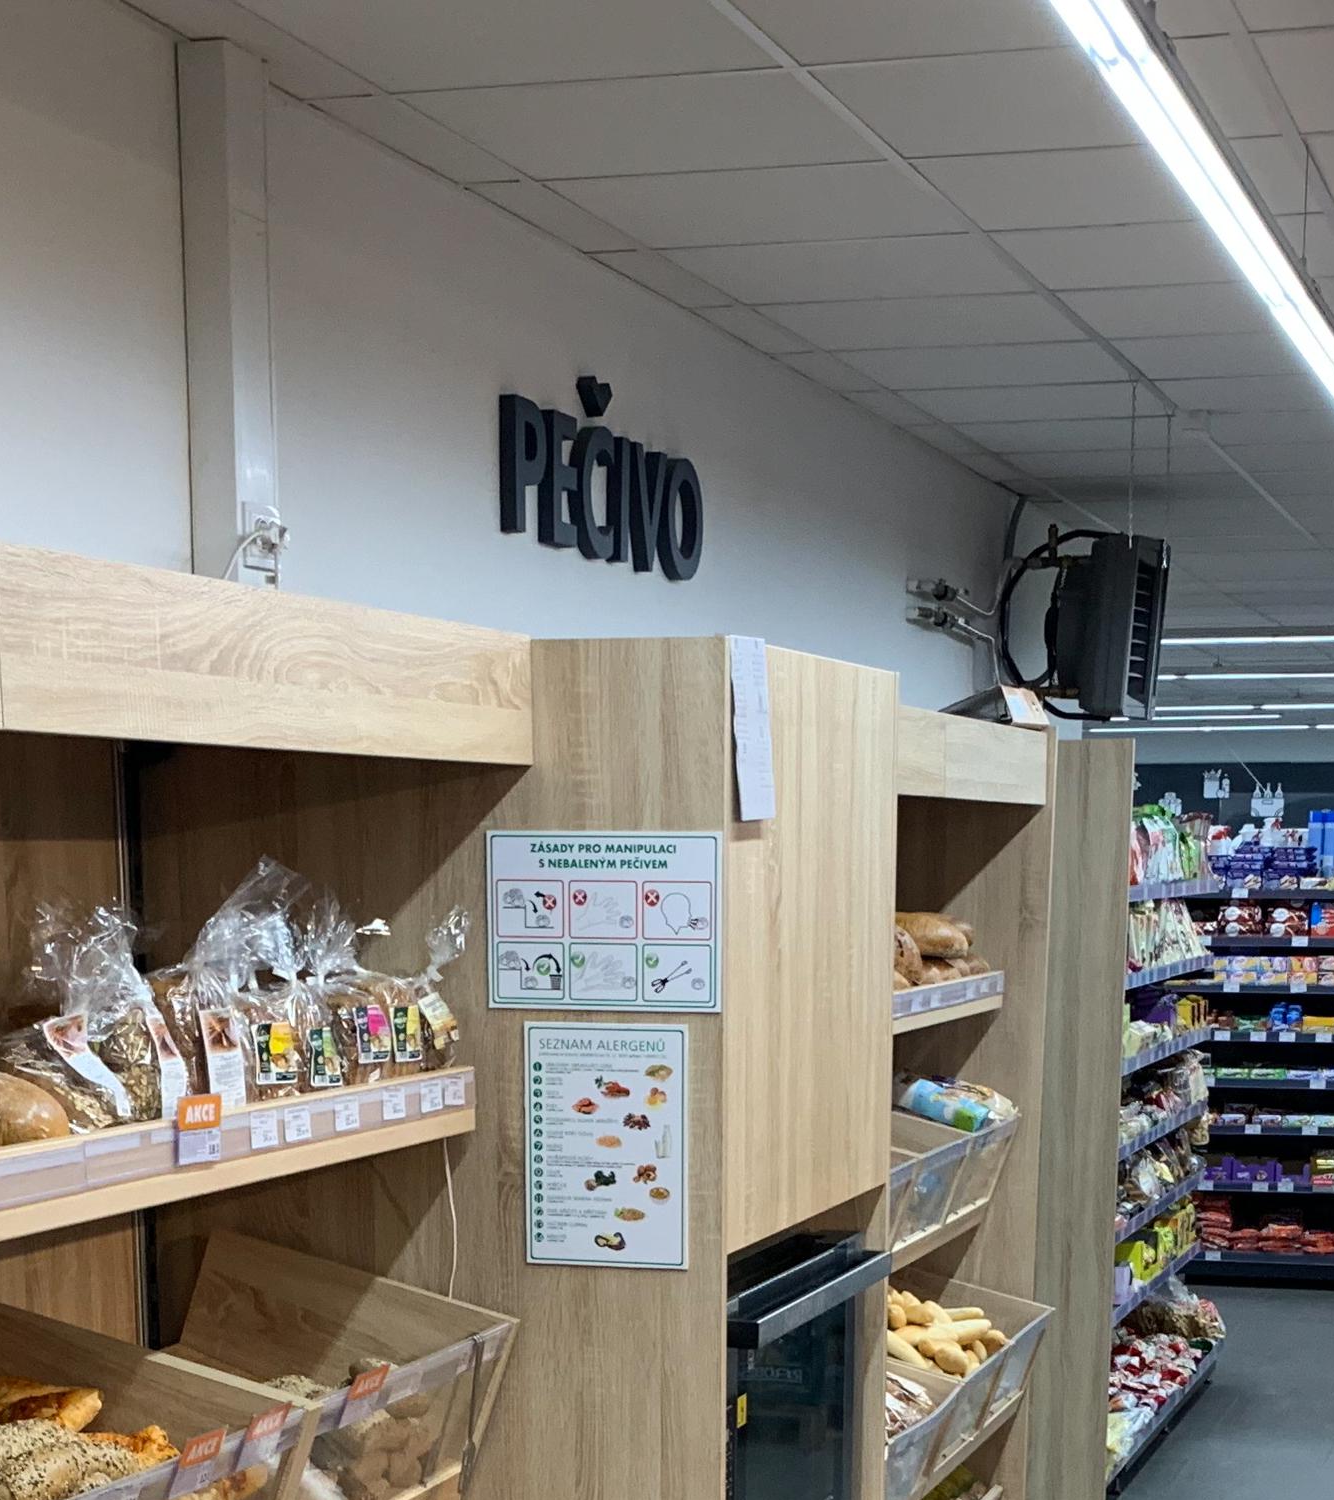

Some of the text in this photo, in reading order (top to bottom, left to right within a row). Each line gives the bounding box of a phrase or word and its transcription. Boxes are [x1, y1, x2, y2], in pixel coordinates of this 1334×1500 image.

[499, 376, 703, 581] PEČIVO
[530, 841, 677, 855] ZÁSADY PRO MANIPULACI
[538, 857, 668, 869] S NEBALENÝM PEČIVEM
[539, 1038, 665, 1052] SEZNAM ALERGENŮ
[185, 1103, 216, 1124] AKCE
[186, 1435, 217, 1462] AKCE
